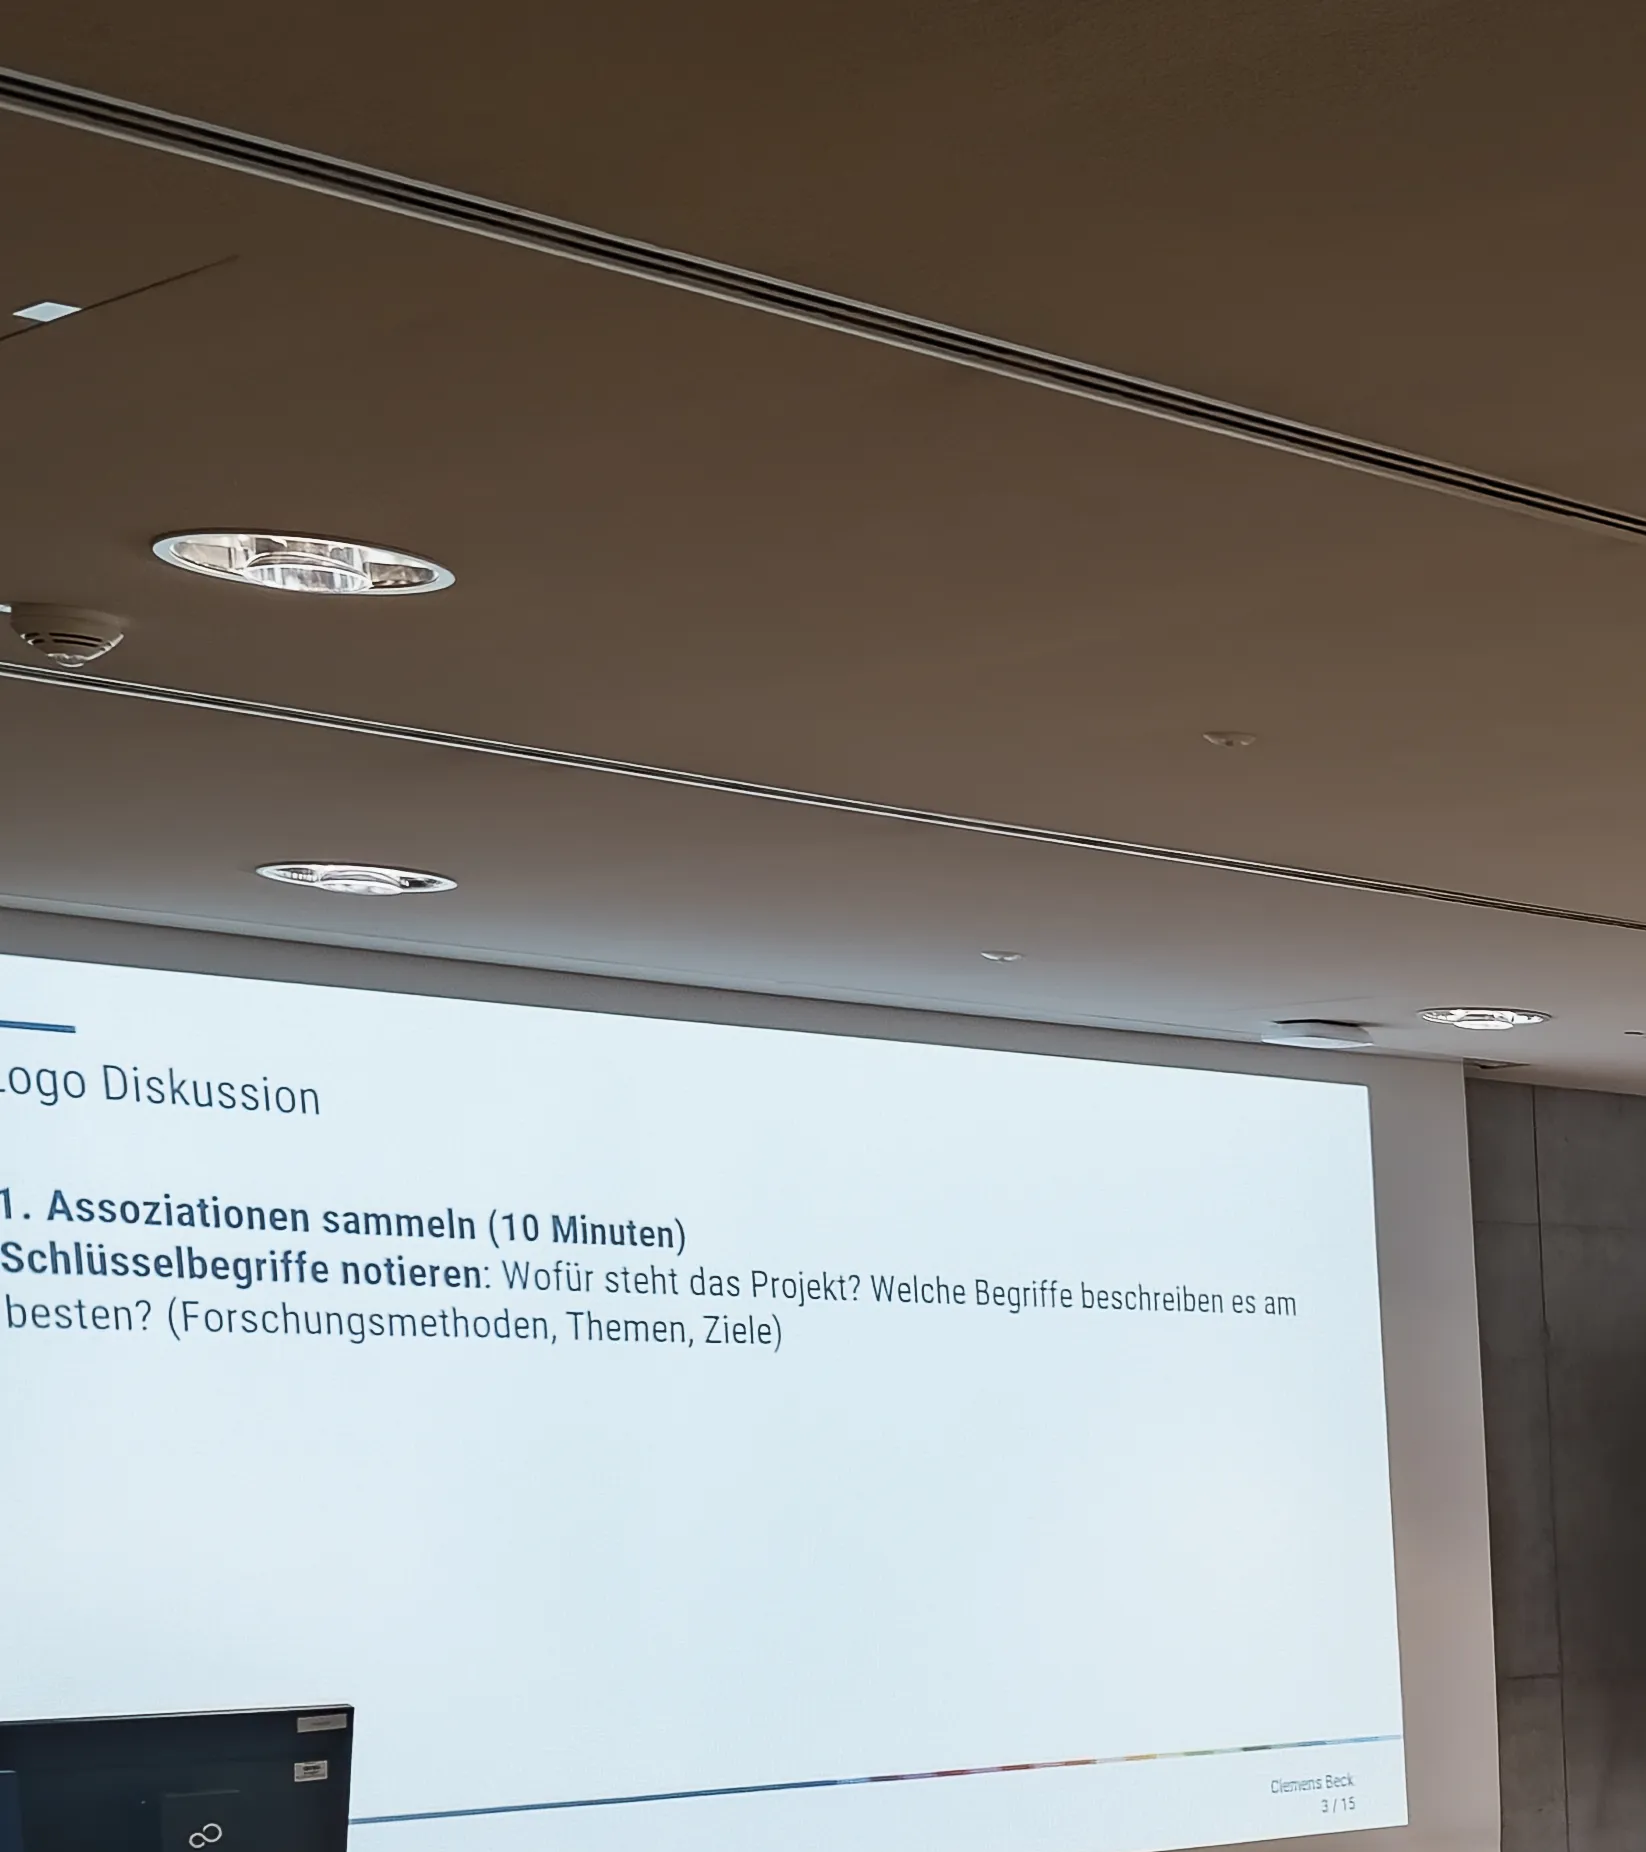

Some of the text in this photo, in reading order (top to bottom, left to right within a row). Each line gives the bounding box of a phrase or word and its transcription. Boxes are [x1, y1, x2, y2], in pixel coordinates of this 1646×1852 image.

[0, 1064, 320, 1115] ogo Diskussion
[0, 1187, 686, 1257] 1. Assoziationen sammeln (10 Minuten)
[0, 1240, 1297, 1316] Schlüsselbegriffe notieren: Wofür steht das Projekt? Welche Begriffe beschreiben es am
[5, 1293, 782, 1353] besten? (Forschungsmethoden, Themen, Ziele)
[1325, 1773, 1354, 1789] Beck
